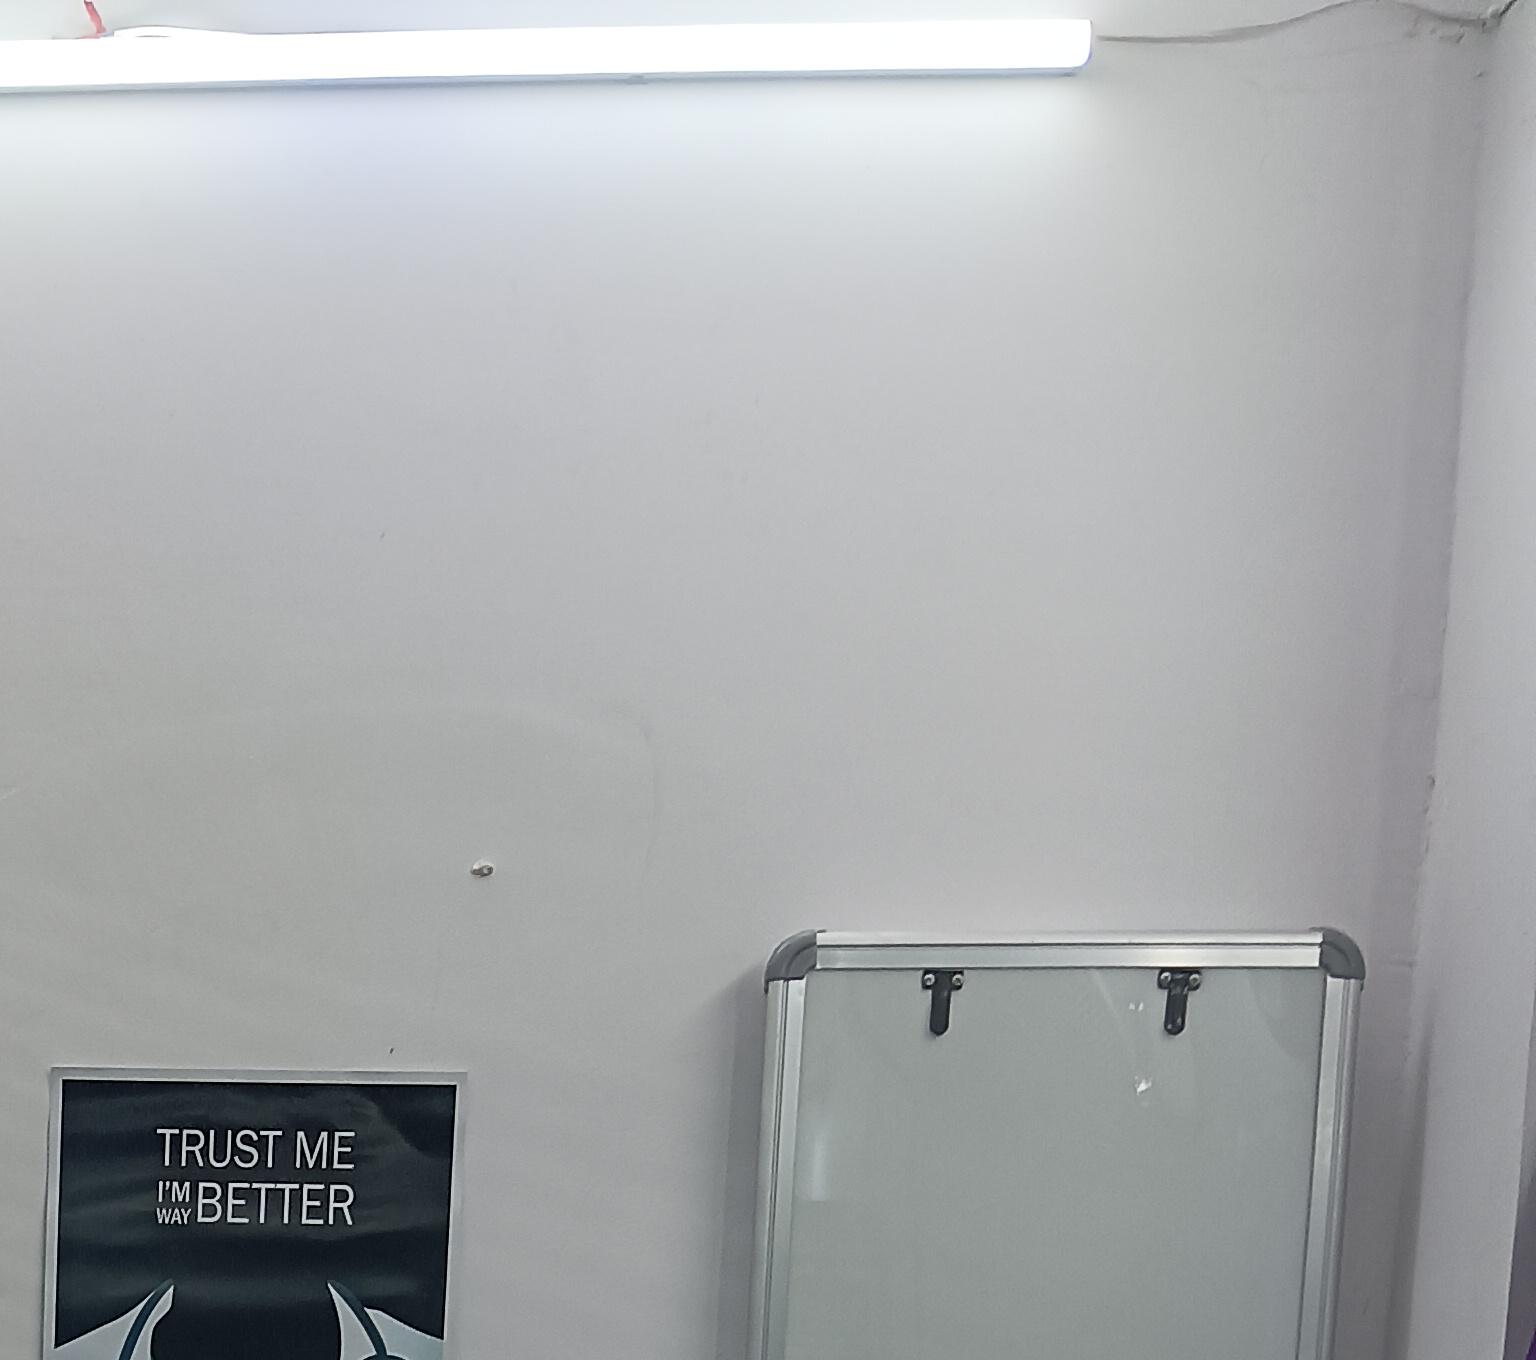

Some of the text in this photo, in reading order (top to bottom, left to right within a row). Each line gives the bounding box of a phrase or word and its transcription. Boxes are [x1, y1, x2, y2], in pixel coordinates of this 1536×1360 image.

[156, 1128, 356, 1169] TRUST ME
[158, 1180, 191, 1202] I'M
[197, 1181, 355, 1226] BETTER
[156, 1207, 191, 1224] WAY
